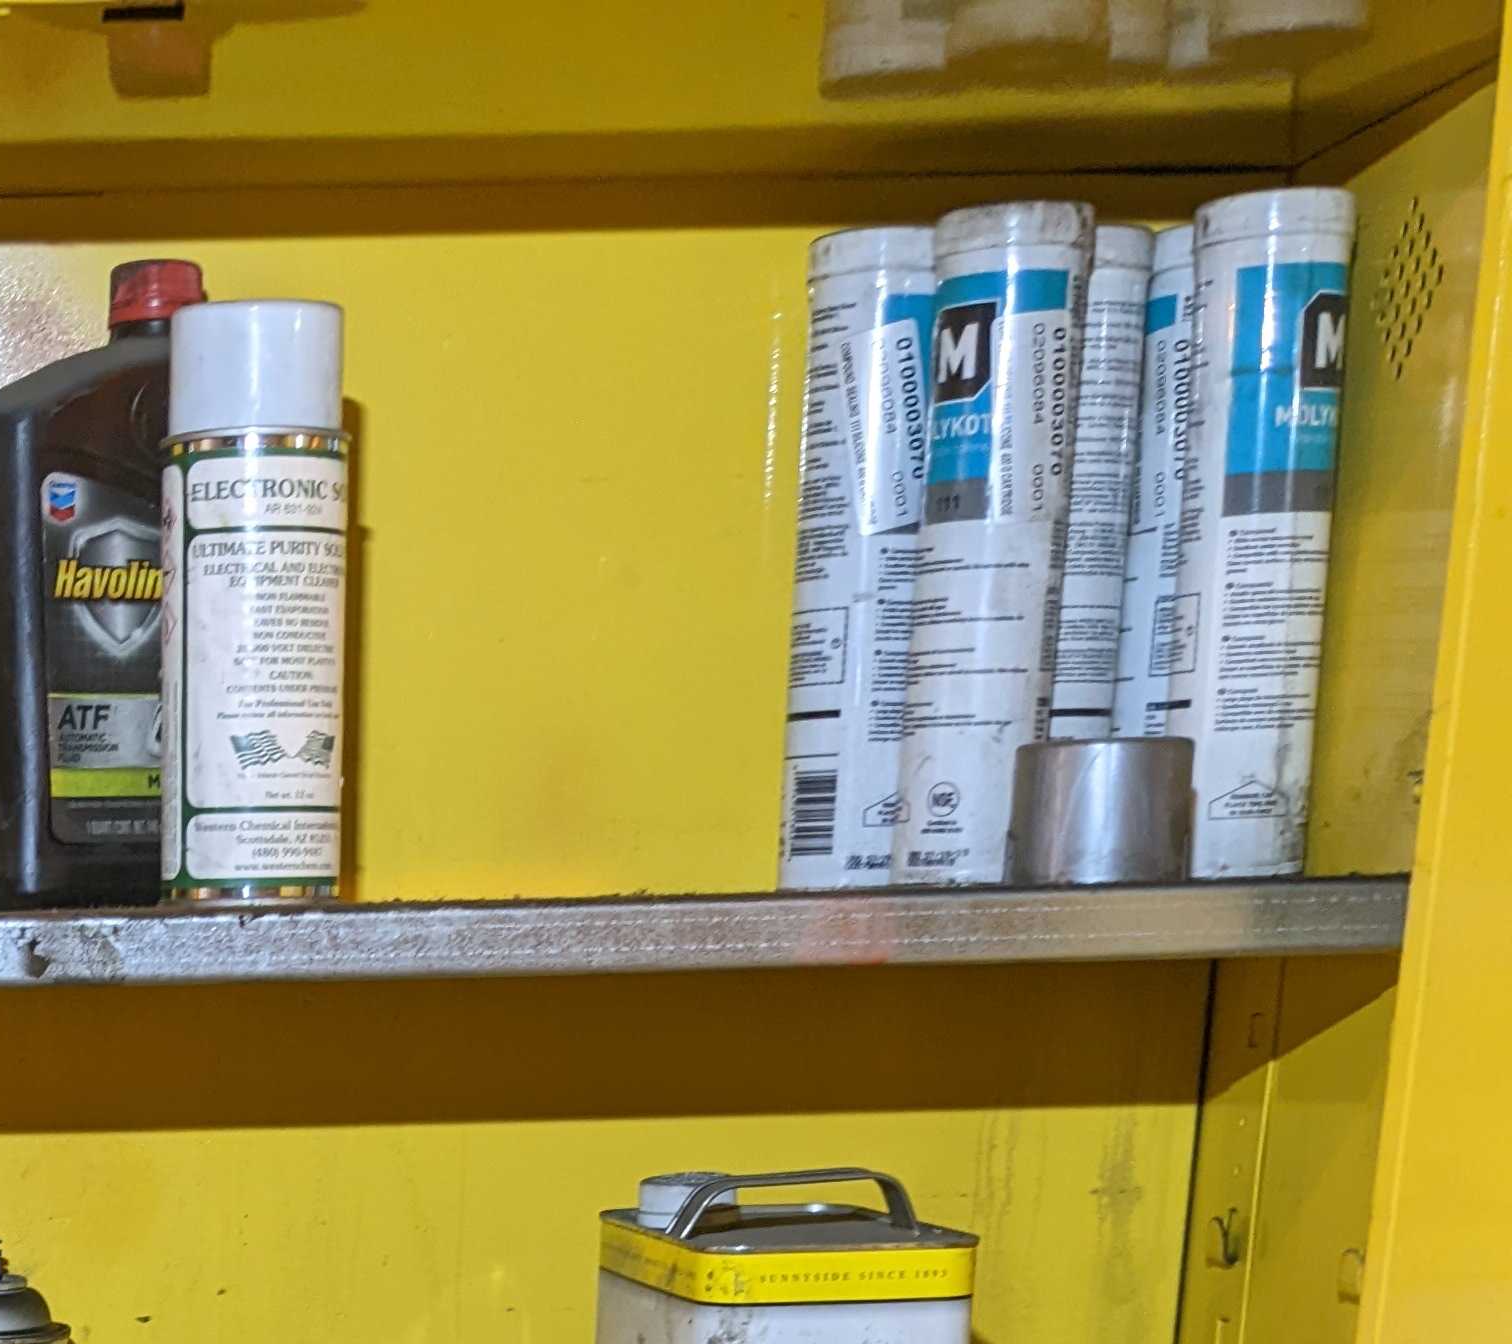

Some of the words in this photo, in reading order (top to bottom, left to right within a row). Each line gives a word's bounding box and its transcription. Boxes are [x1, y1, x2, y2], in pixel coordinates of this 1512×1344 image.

[191, 541, 266, 559] ULTIMAE
[269, 540, 321, 555] PURITY
[203, 562, 279, 576] ELECTRCAL
[55, 559, 164, 599] Havolin
[56, 704, 111, 731] ATF
[759, 1271, 851, 1284] SUNNYSIDE
[857, 1269, 907, 1281] SINCE
